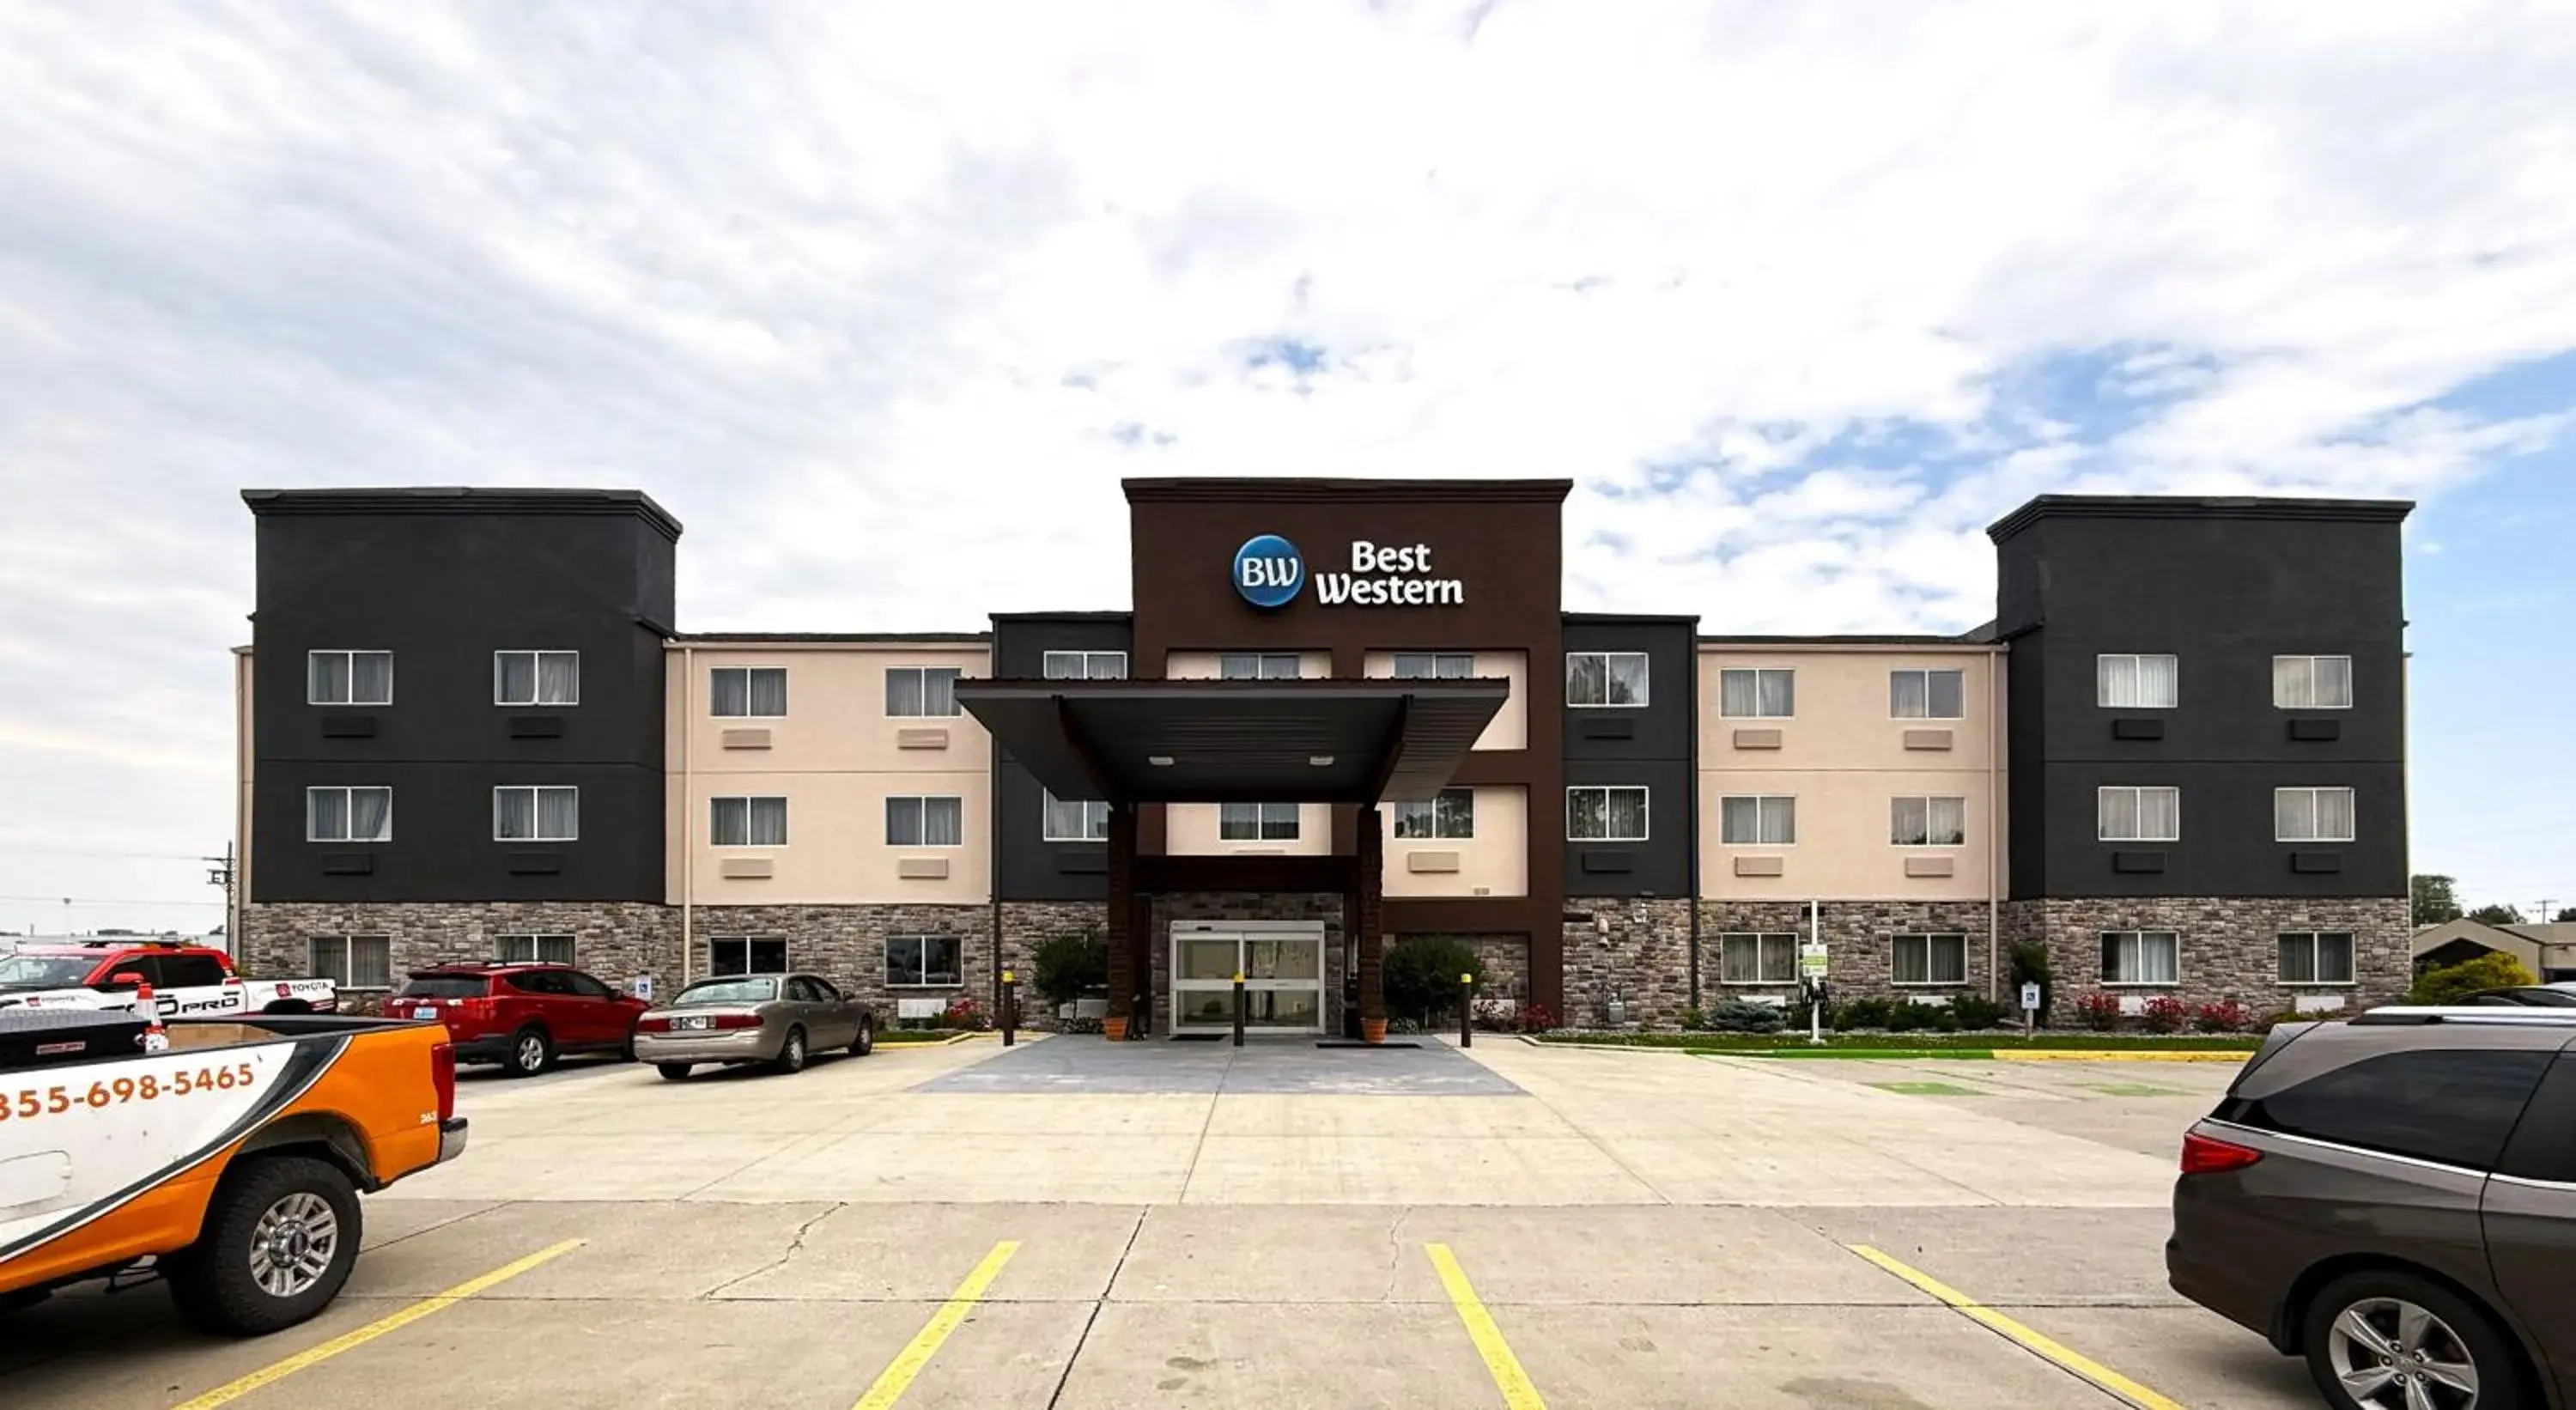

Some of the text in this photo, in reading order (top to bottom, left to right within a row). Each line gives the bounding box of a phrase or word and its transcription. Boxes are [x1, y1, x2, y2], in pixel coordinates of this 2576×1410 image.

[1242, 557, 1298, 587] BW
[1352, 540, 1431, 574] Best
[1315, 573, 1464, 605] Western
[181, 991, 240, 1013] PRO
